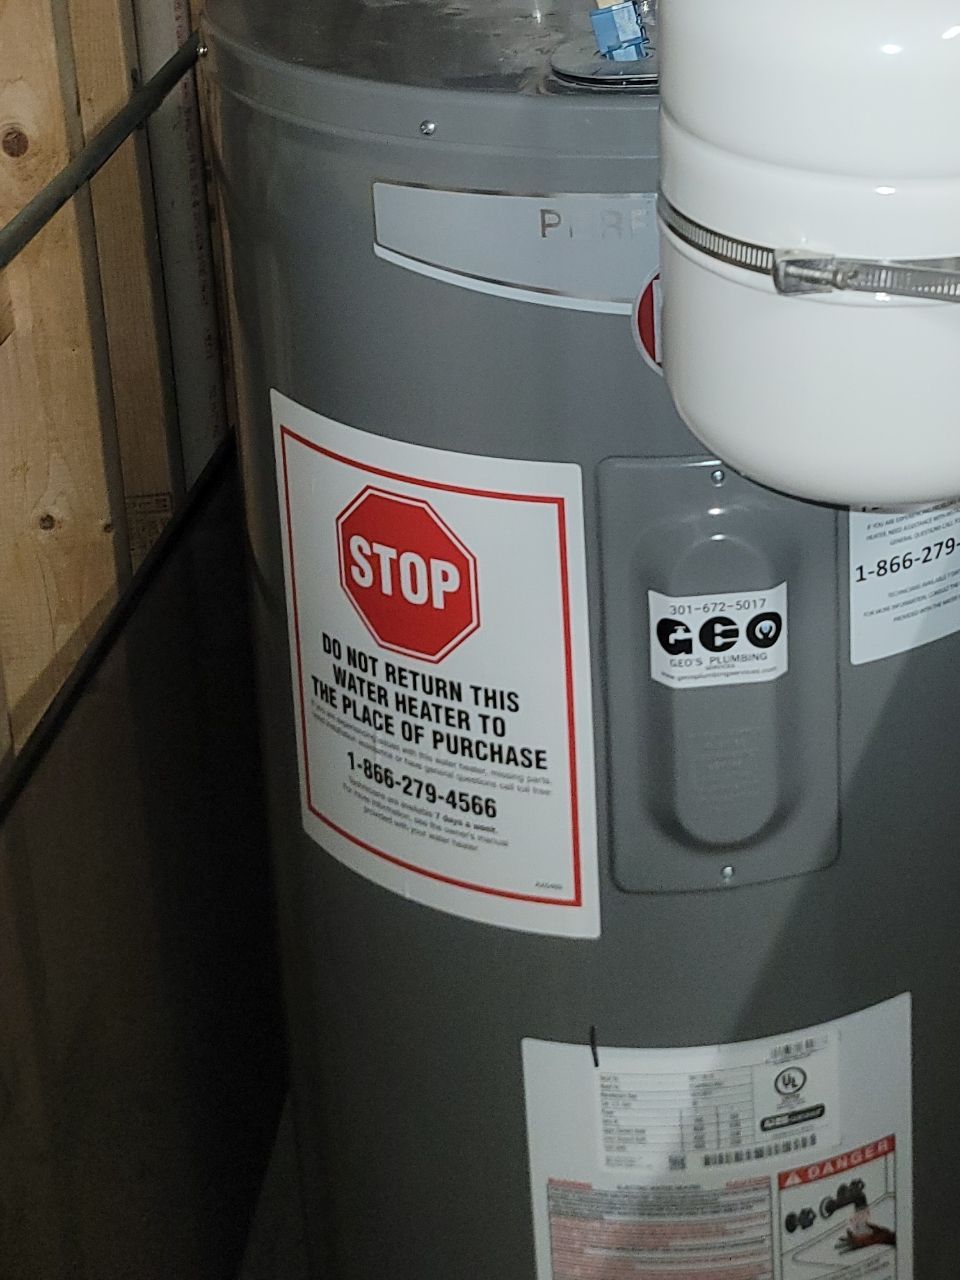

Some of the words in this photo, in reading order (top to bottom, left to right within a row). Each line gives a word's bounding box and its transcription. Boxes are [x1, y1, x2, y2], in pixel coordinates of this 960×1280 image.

[349, 534, 463, 611] STOP
[656, 611, 783, 656] GEO
[670, 598, 767, 616] 301-672-5017
[322, 631, 343, 661] DO
[347, 645, 379, 677] NOT
[385, 662, 463, 703] RETURN
[470, 685, 520, 713] THIS
[669, 657, 704, 668] GEO'S
[709, 652, 769, 665] PLUMBING
[311, 675, 338, 710] THE
[343, 693, 396, 737] PLACE
[401, 721, 426, 746] OF
[432, 729, 549, 771] PURCHASE
[333, 665, 390, 708] WATER
[395, 691, 471, 732] HEATER
[478, 713, 506, 739] TO
[347, 751, 498, 819] 1-866-279-4566
[807, 1138, 890, 1179] DANGER
